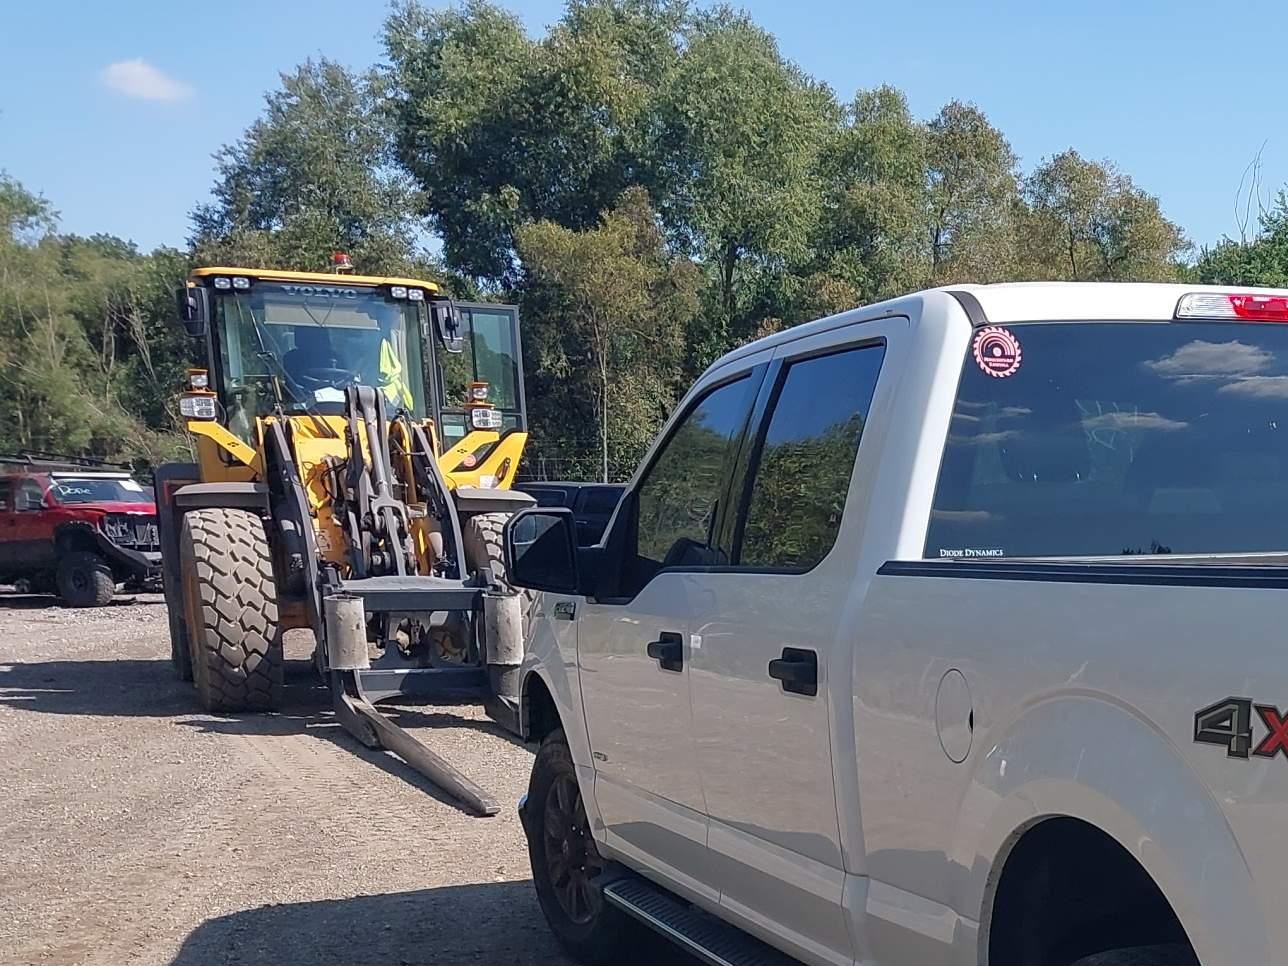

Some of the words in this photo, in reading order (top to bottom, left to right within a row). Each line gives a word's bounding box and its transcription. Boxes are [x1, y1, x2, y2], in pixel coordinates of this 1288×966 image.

[280, 285, 357, 299] VOLVO
[940, 549, 963, 557] DIODE
[965, 549, 1004, 557] DYNAMICS
